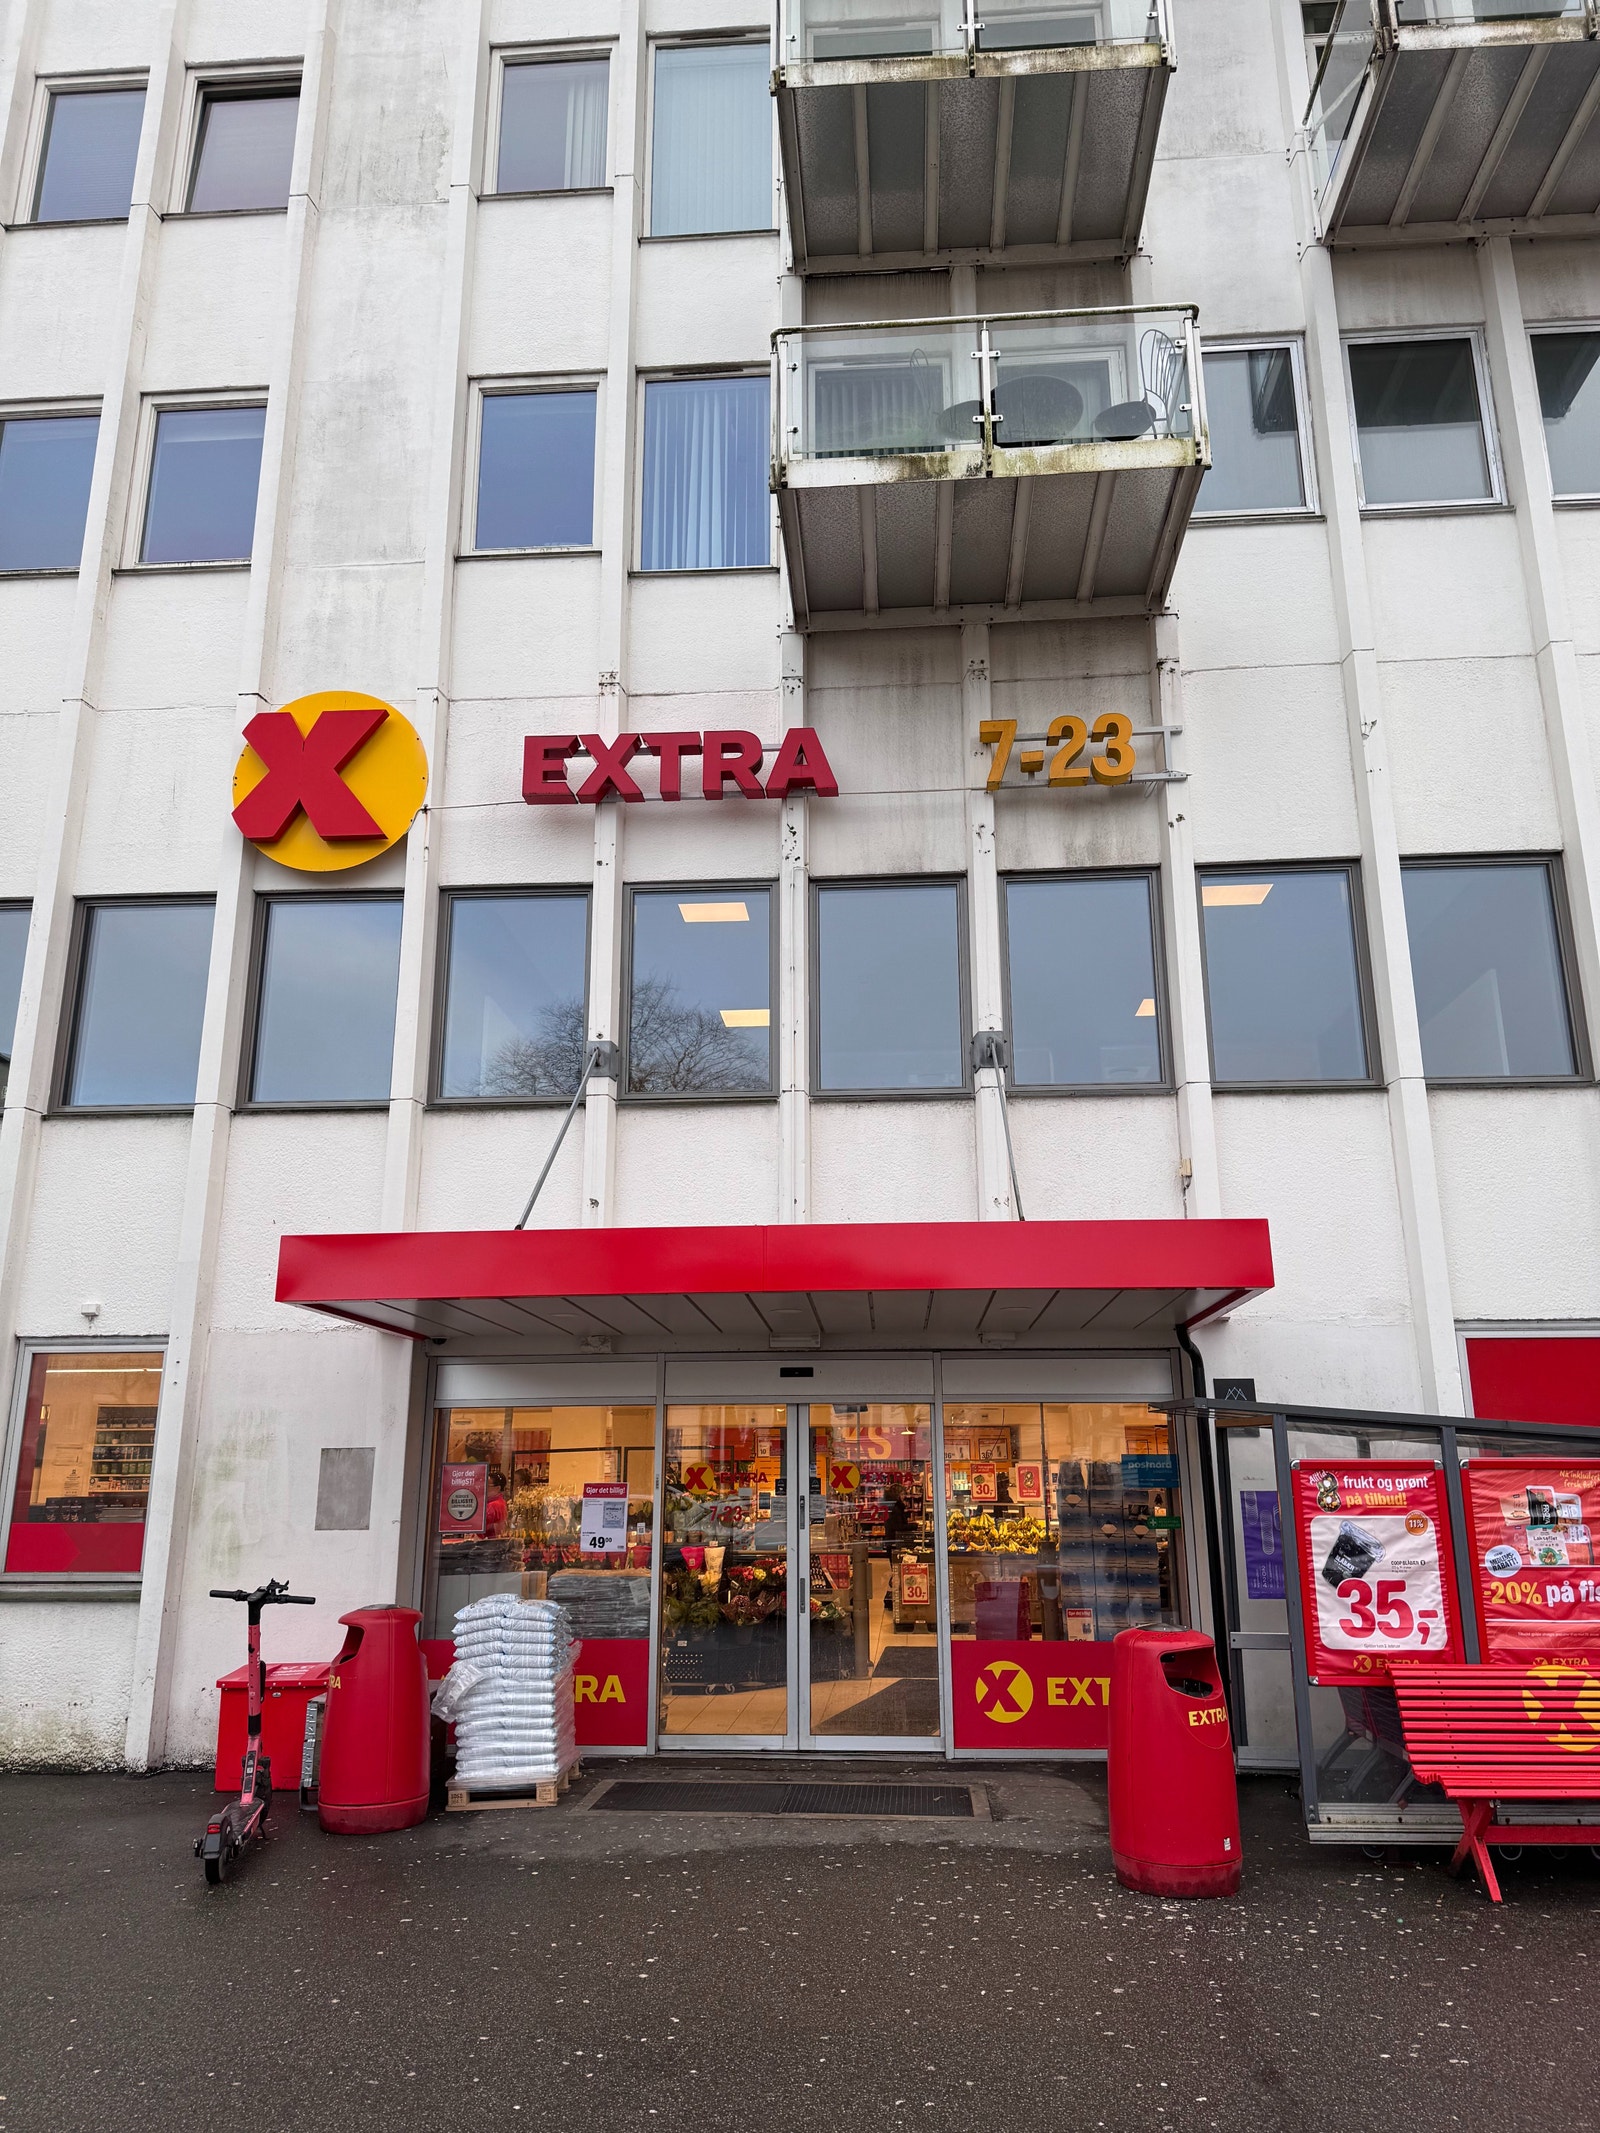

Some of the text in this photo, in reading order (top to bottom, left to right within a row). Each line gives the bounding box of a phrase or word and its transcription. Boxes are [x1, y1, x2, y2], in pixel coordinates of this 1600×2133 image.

[980, 712, 1135, 790] 7-23
[522, 726, 839, 805] EXTRA
[1128, 1460, 1172, 1470] postnord
[720, 1472, 768, 1484] EXTRA
[861, 1472, 914, 1484] EXTRA
[1343, 1475, 1429, 1491] frukt og grønt
[1345, 1492, 1408, 1507] på tilbud!
[1408, 1519, 1424, 1529] 11%
[1492, 1557, 1519, 1571] RABATT!
[1483, 1581, 1543, 1605] -20%
[1545, 1580, 1575, 1608] på
[1552, 1657, 1590, 1666] EXTRA
[574, 1674, 627, 1703] RA
[1188, 1705, 1228, 1727] EXTRA
